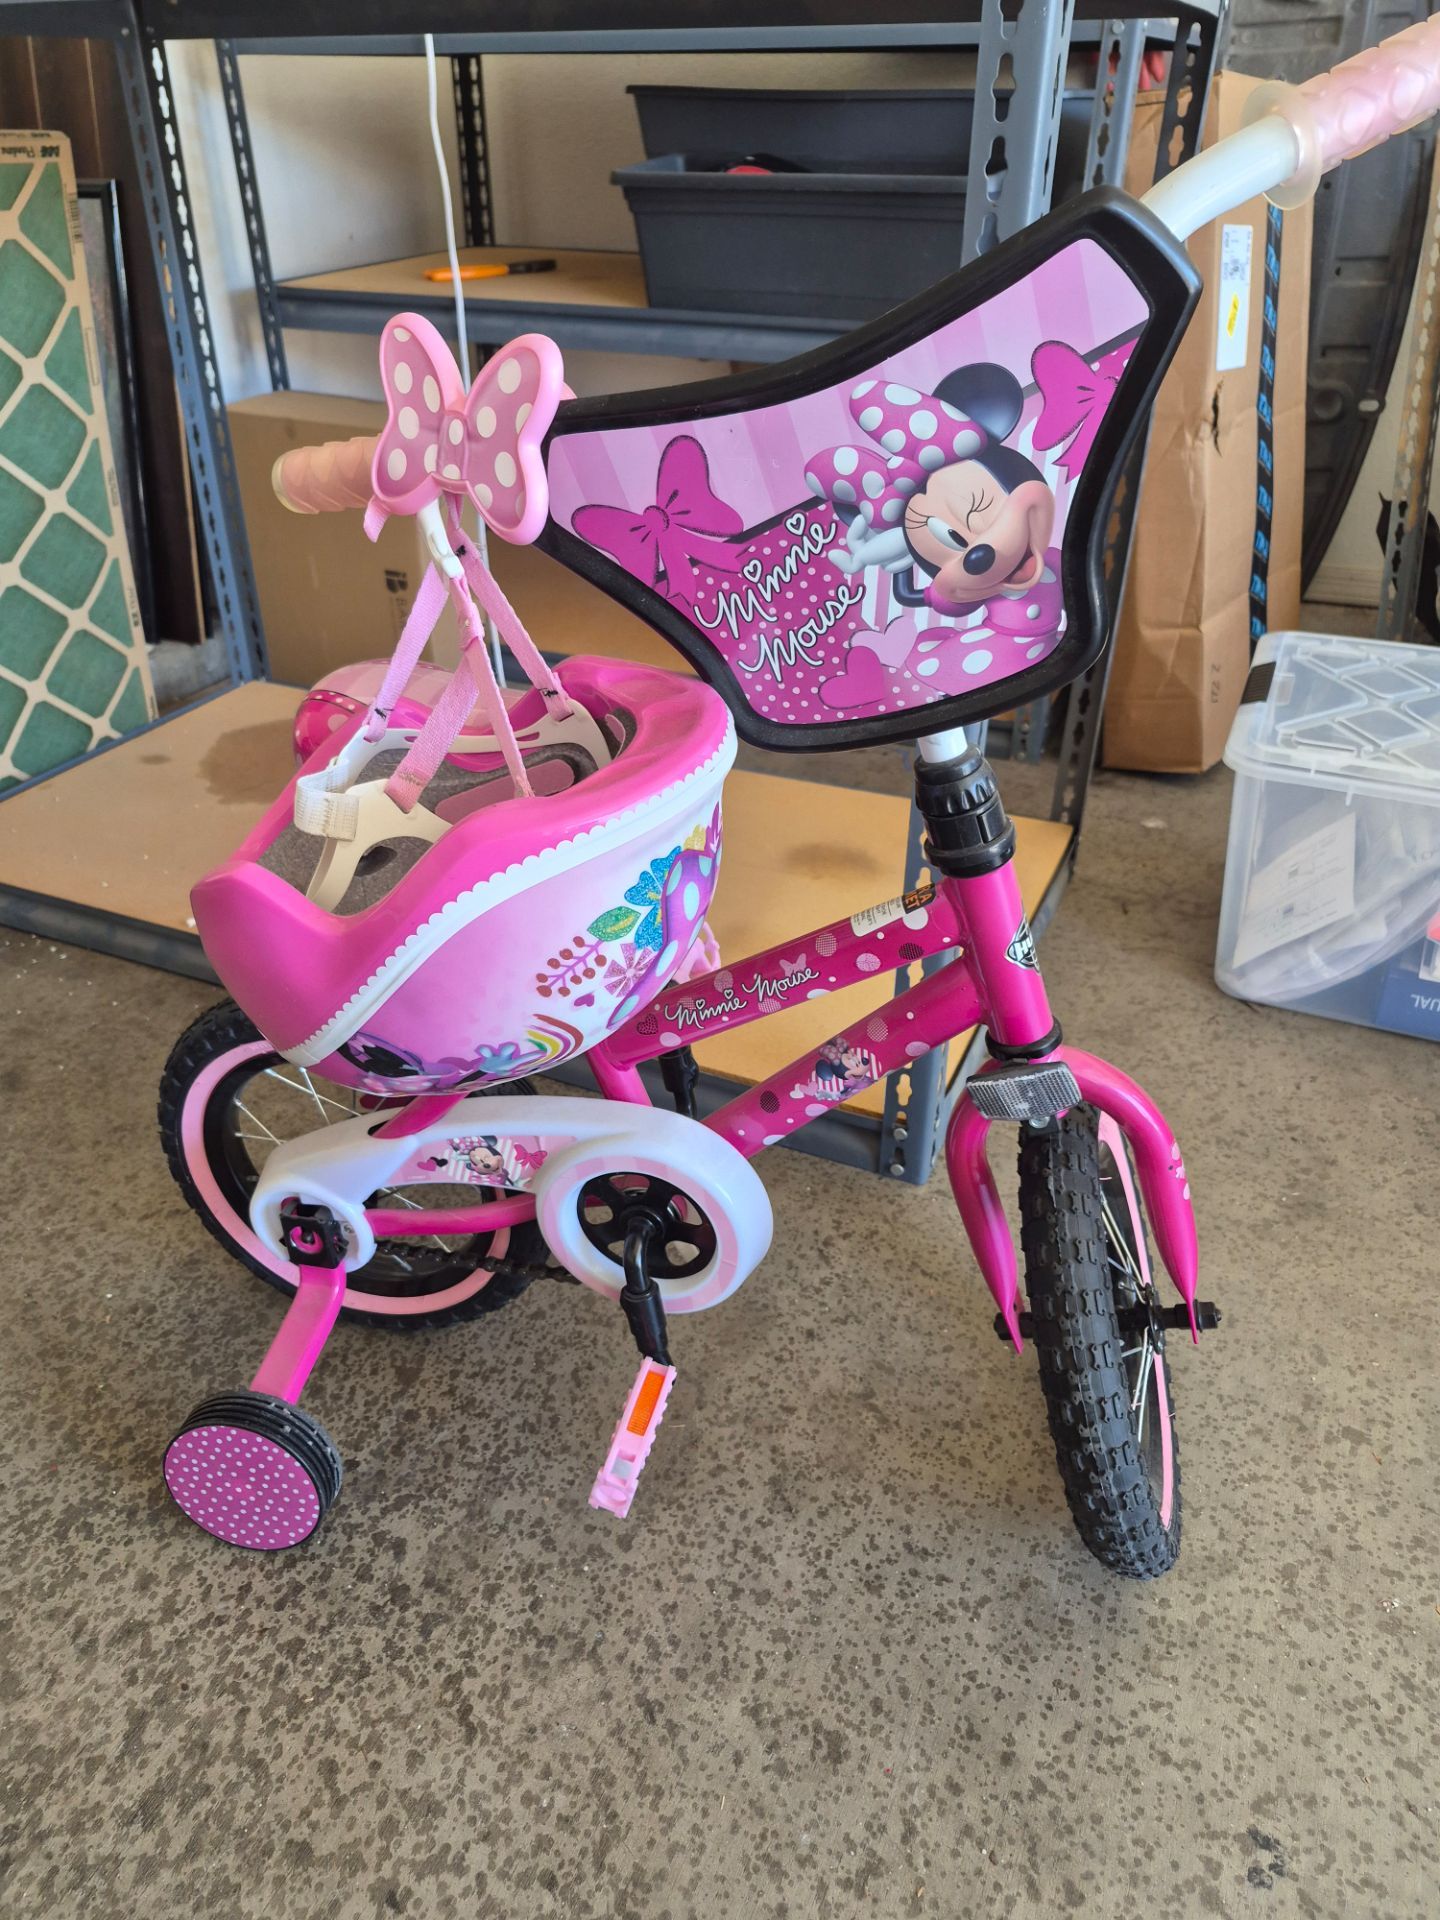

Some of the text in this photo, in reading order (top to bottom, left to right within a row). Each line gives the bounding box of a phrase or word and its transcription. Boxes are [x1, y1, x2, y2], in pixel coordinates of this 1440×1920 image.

[693, 513, 837, 639] Minnie
[737, 584, 866, 683] Mouse
[664, 967, 820, 1030] Minnie Mouse
